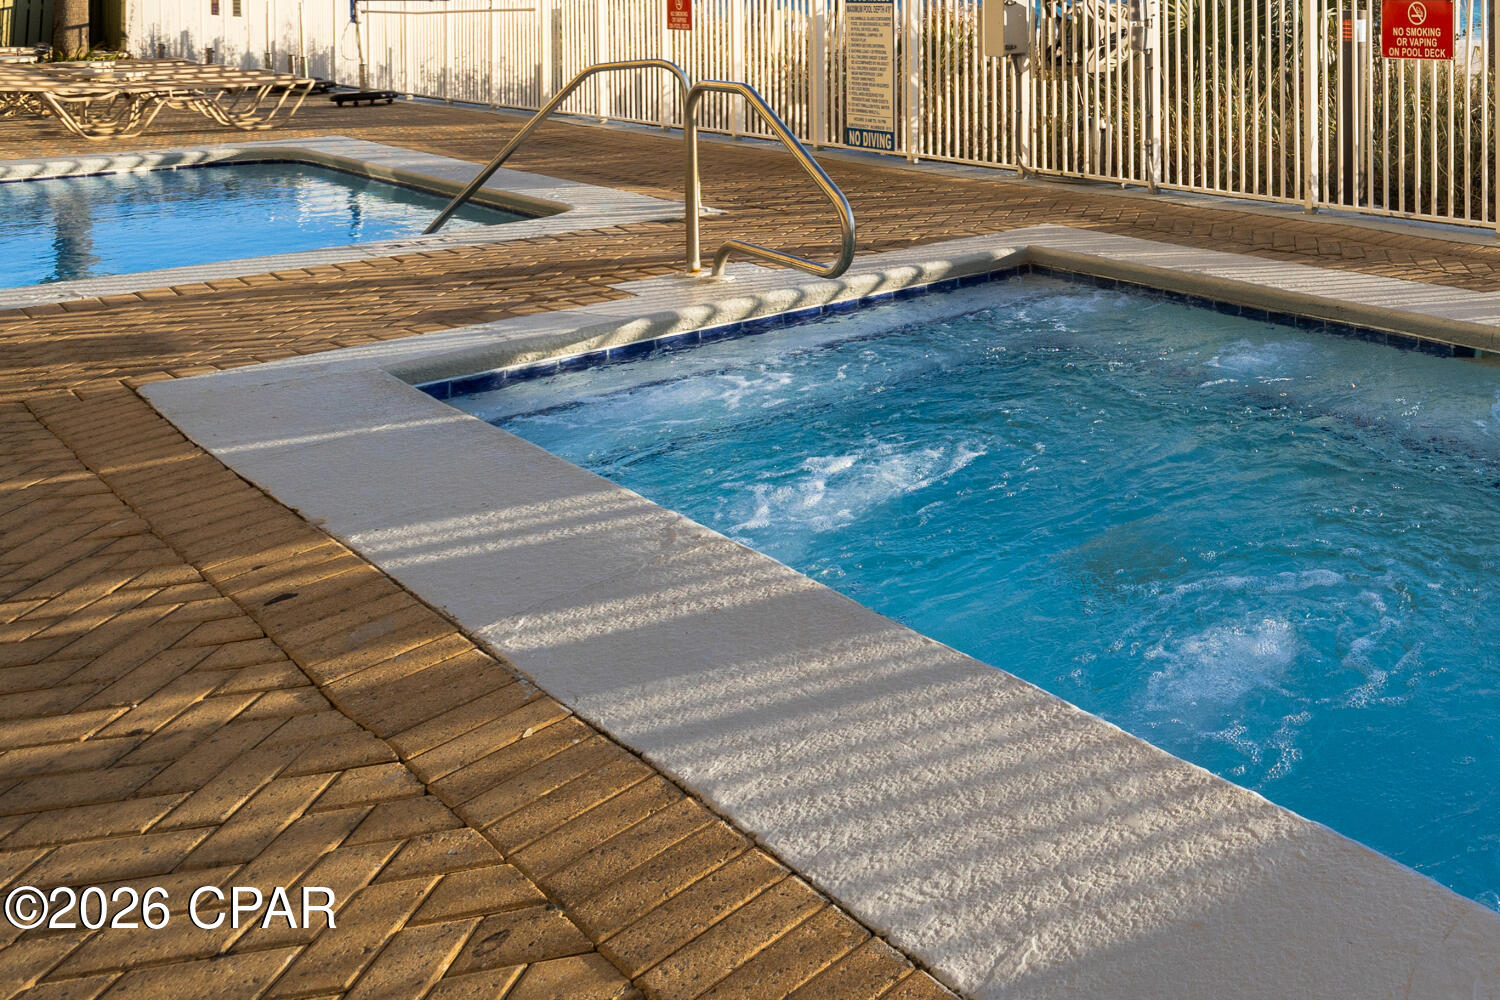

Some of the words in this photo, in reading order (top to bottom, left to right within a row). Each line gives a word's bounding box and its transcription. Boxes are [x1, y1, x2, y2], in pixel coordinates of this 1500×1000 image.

[1393, 28, 1404, 36] NO
[1406, 28, 1441, 37] SMOKING
[1396, 38, 1408, 46] OR
[1409, 38, 1437, 47] VAPING
[1389, 48, 1400, 56] ON
[1402, 48, 1422, 57] POOL
[1425, 49, 1446, 58] DECK
[849, 130, 860, 146] NO
[863, 131, 892, 149] DIVING
